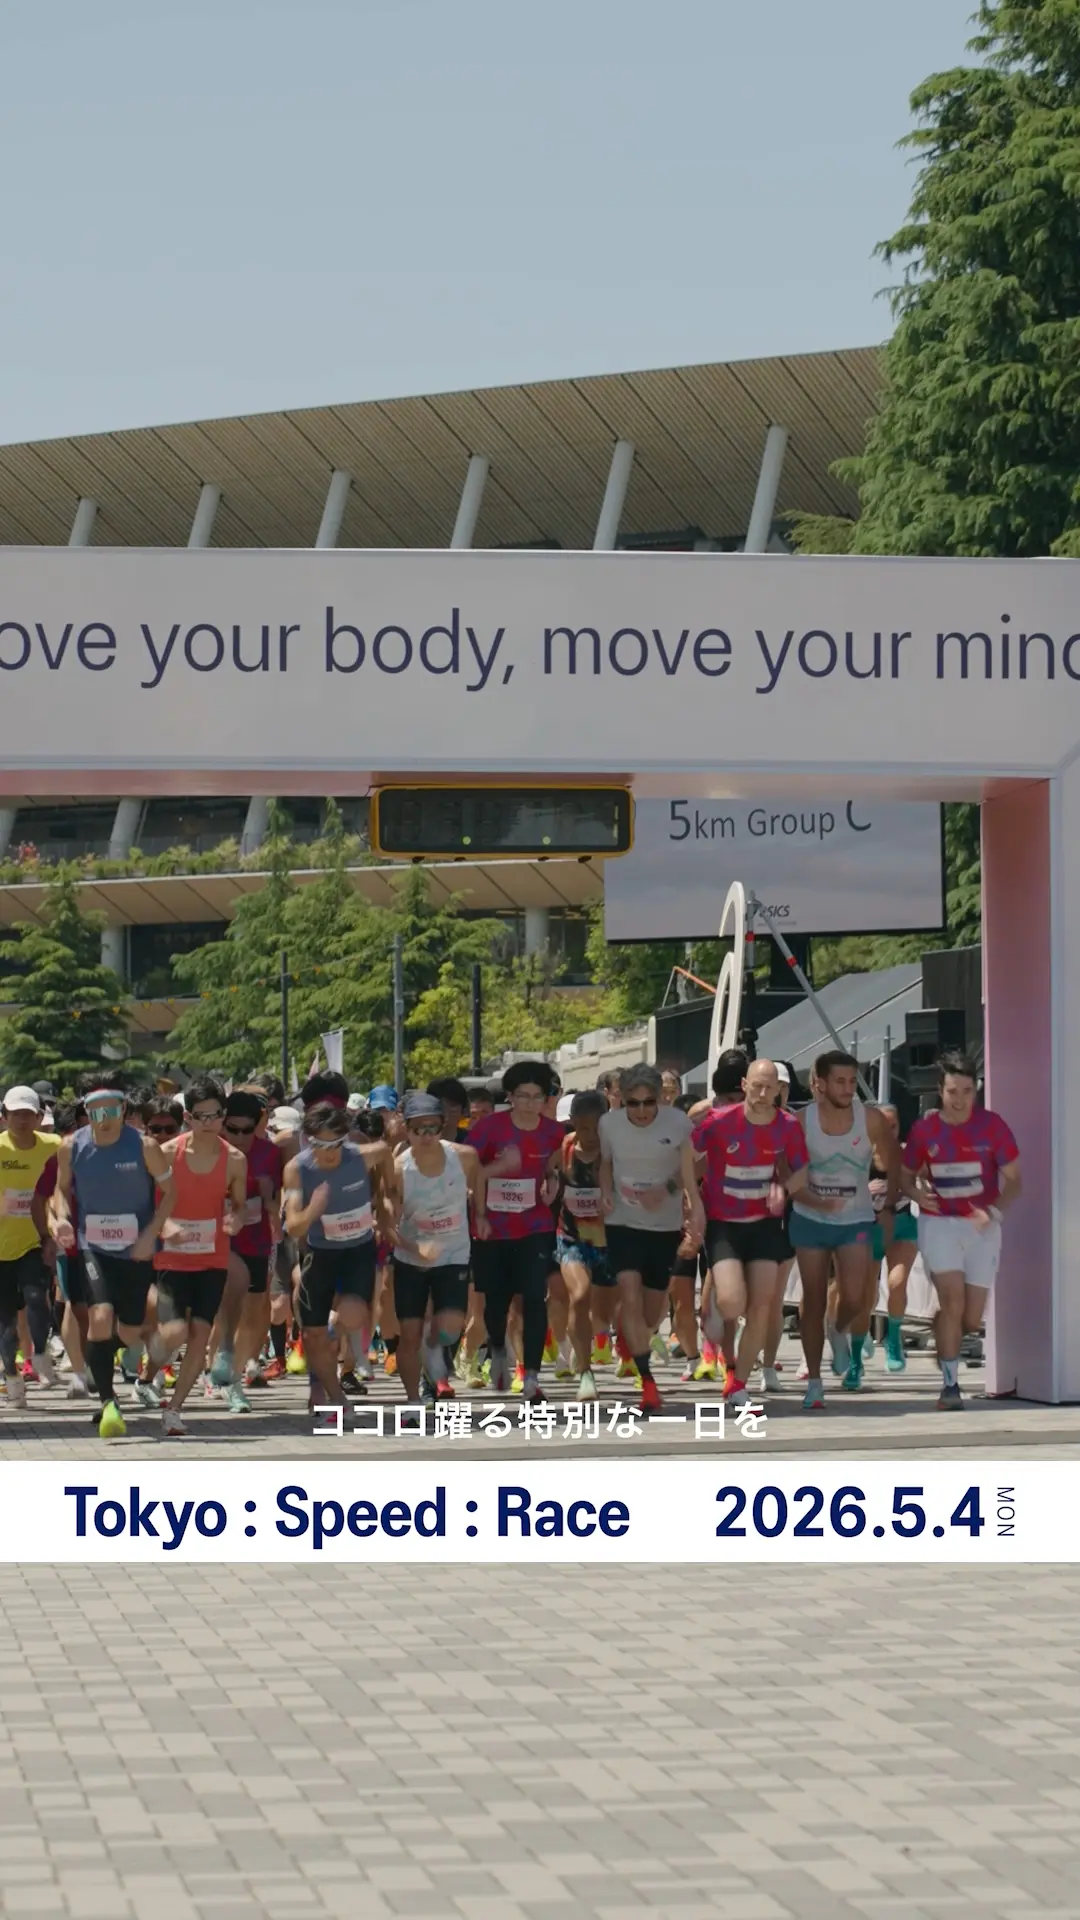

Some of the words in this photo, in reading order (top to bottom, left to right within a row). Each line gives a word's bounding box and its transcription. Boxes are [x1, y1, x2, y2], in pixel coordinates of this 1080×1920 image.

[140, 623, 301, 689] your
[325, 606, 514, 692] body,
[544, 627, 732, 676] move
[755, 630, 912, 695] your
[669, 800, 735, 840] 5km
[747, 808, 835, 840] Group
[101, 1228, 123, 1239] 1820
